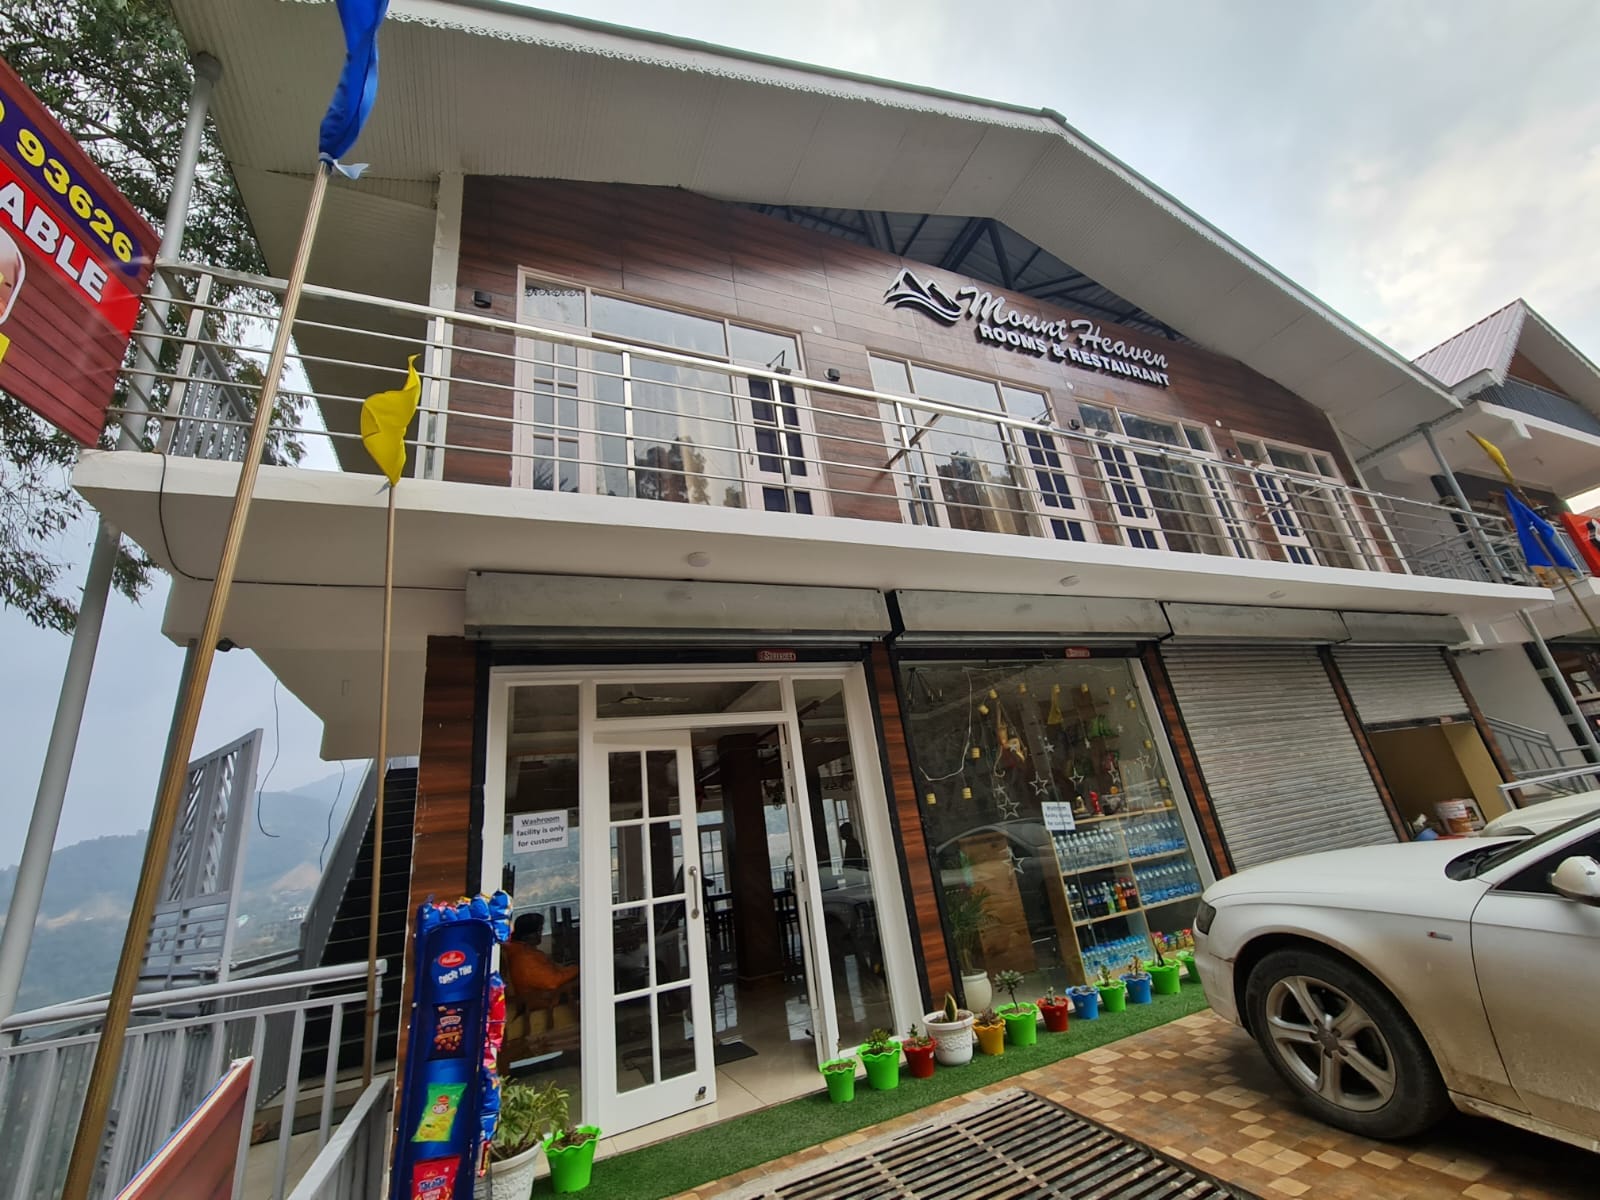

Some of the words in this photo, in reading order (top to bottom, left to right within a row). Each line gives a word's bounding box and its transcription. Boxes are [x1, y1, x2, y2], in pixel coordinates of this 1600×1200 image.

[16, 128, 133, 263] 93626
[0, 182, 109, 303] ABLE
[960, 286, 1068, 340] Mount
[1071, 319, 1169, 368] Heaven
[979, 323, 1048, 353] ROOMS
[1053, 343, 1068, 358] &
[1068, 347, 1170, 386] RESTAURANT
[516, 828, 540, 836] facility
[549, 824, 564, 832] only
[521, 815, 560, 825] Washroom
[530, 836, 563, 846] customer
